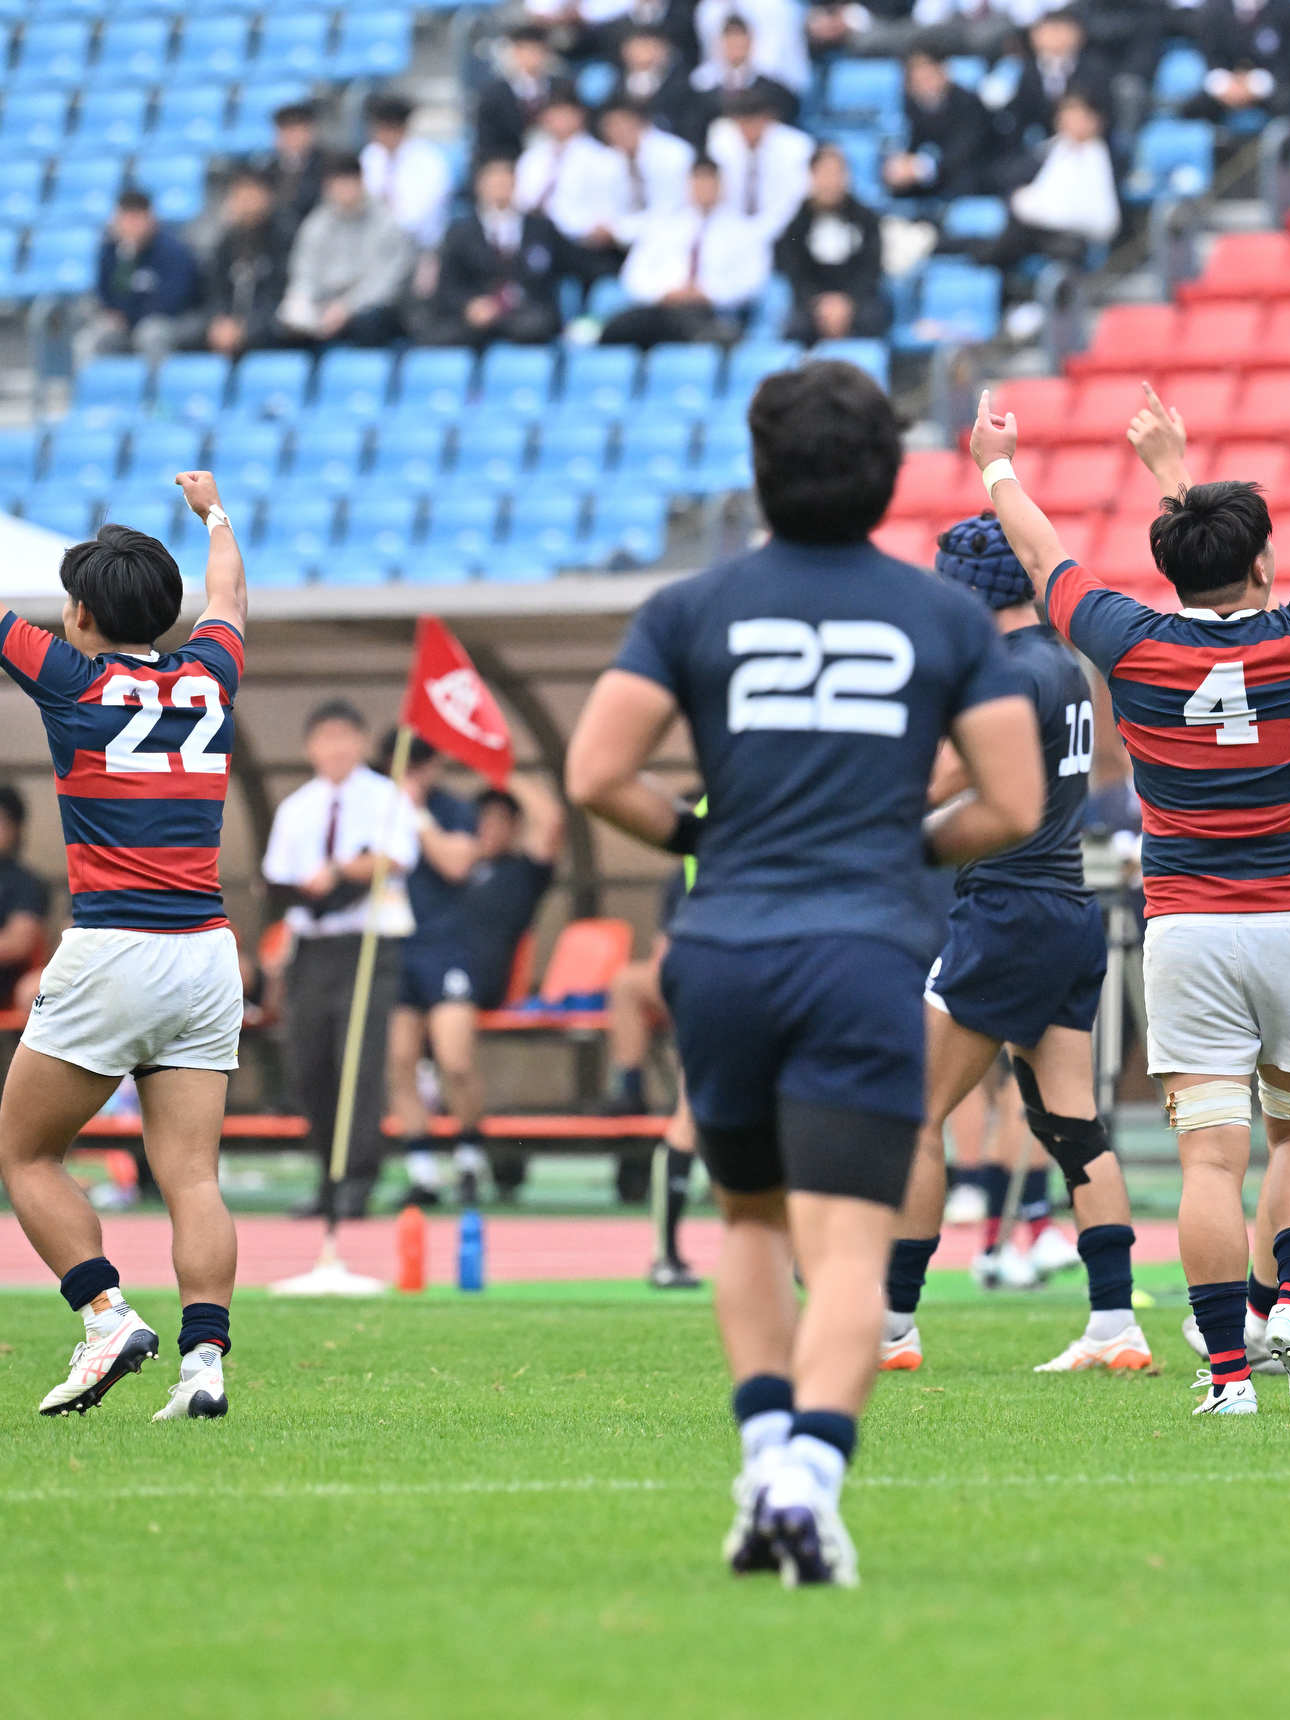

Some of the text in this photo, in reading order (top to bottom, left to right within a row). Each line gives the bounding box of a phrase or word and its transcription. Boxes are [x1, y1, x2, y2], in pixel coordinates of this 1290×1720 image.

[728, 617, 915, 738] 22
[1184, 660, 1260, 745] 4
[101, 674, 227, 775] 22
[1058, 700, 1094, 777] 10
